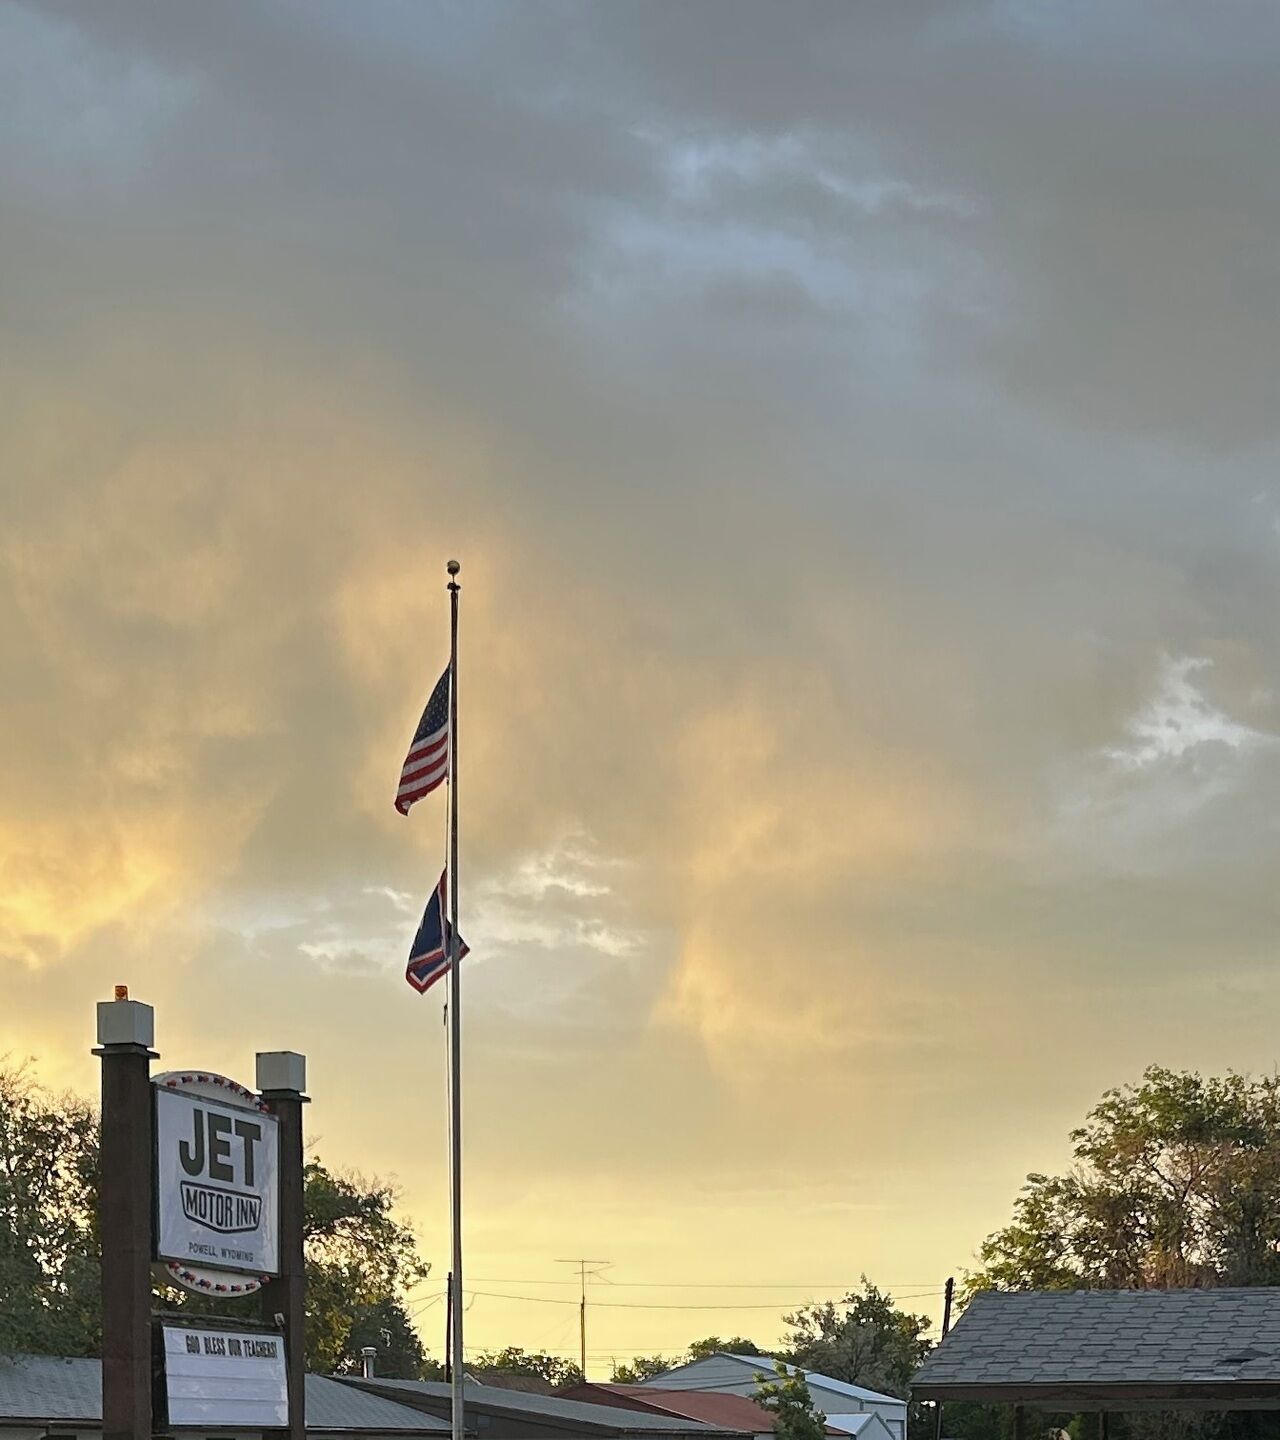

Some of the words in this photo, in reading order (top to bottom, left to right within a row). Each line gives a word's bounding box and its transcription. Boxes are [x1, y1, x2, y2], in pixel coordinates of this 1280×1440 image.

[179, 1108, 262, 1187] JET
[186, 1188, 233, 1227] MOTOR
[236, 1198, 258, 1227] INN
[188, 1241, 218, 1258] POWELL,
[221, 1247, 254, 1262] WYOMING
[185, 1334, 200, 1354] GOD
[203, 1336, 226, 1356] BLESS
[228, 1338, 242, 1357] OUR
